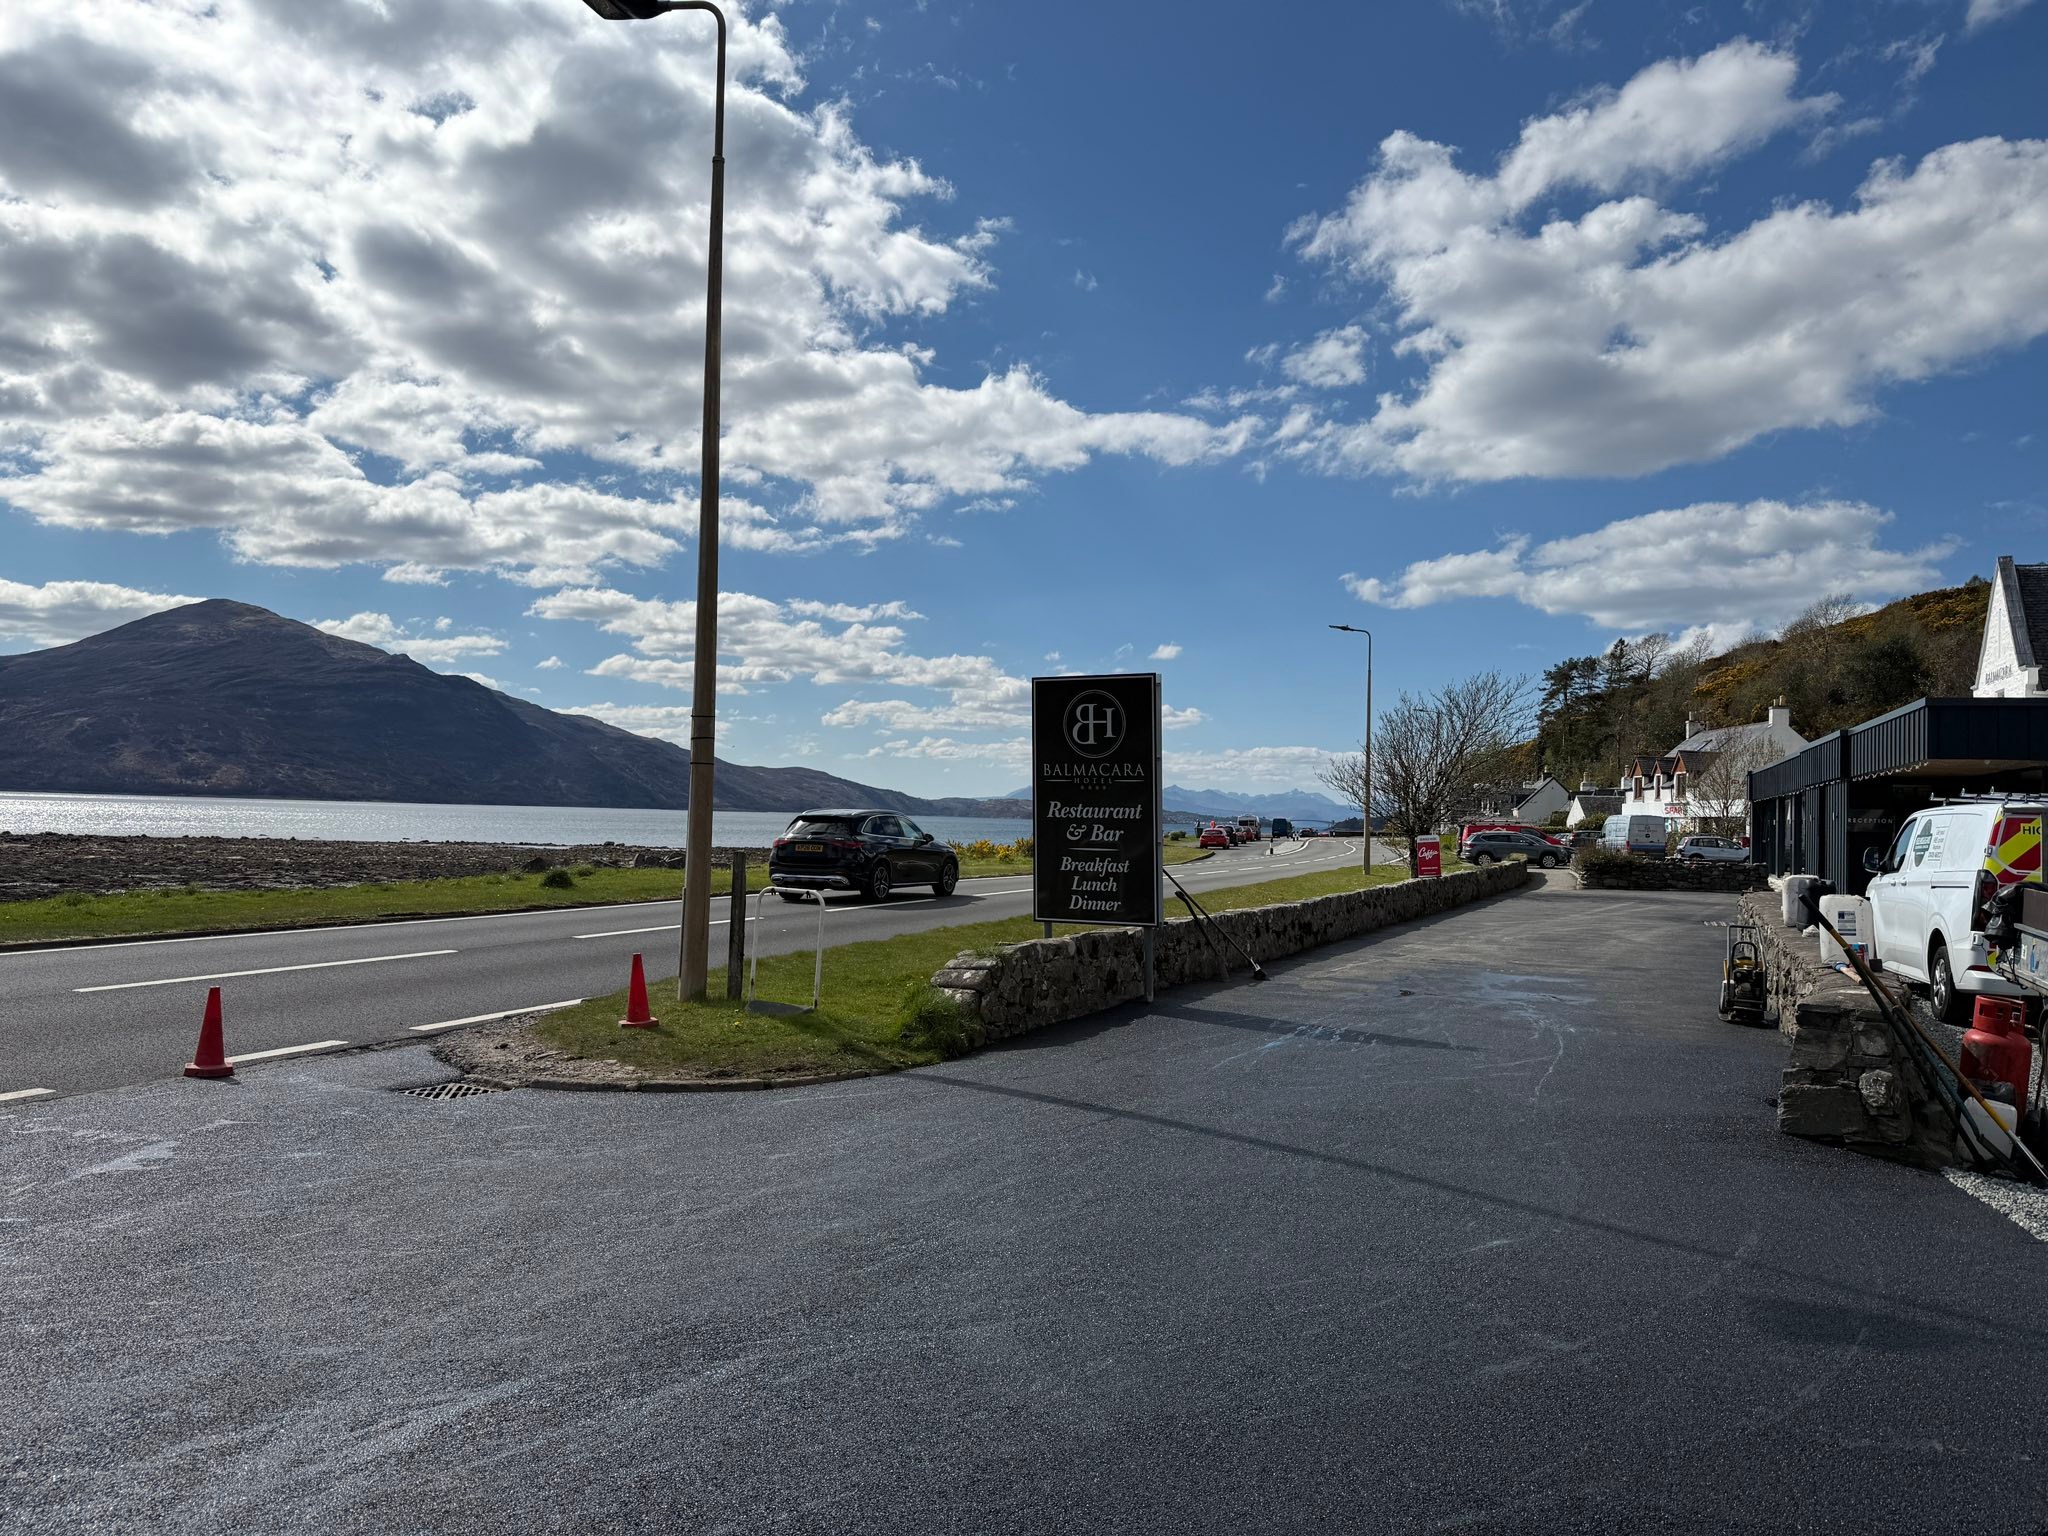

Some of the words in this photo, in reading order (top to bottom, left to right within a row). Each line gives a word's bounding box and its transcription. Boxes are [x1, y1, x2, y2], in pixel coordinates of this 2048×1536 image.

[1043, 763, 1145, 777] BALMACARA
[1074, 777, 1113, 785] HOTEL
[1047, 801, 1142, 820] Restaurant
[1066, 824, 1087, 841] &
[1090, 825, 1125, 842] Bar
[1060, 856, 1130, 878] Breakfast
[1071, 876, 1118, 892] Lunch
[1068, 895, 1122, 912] Dinner
